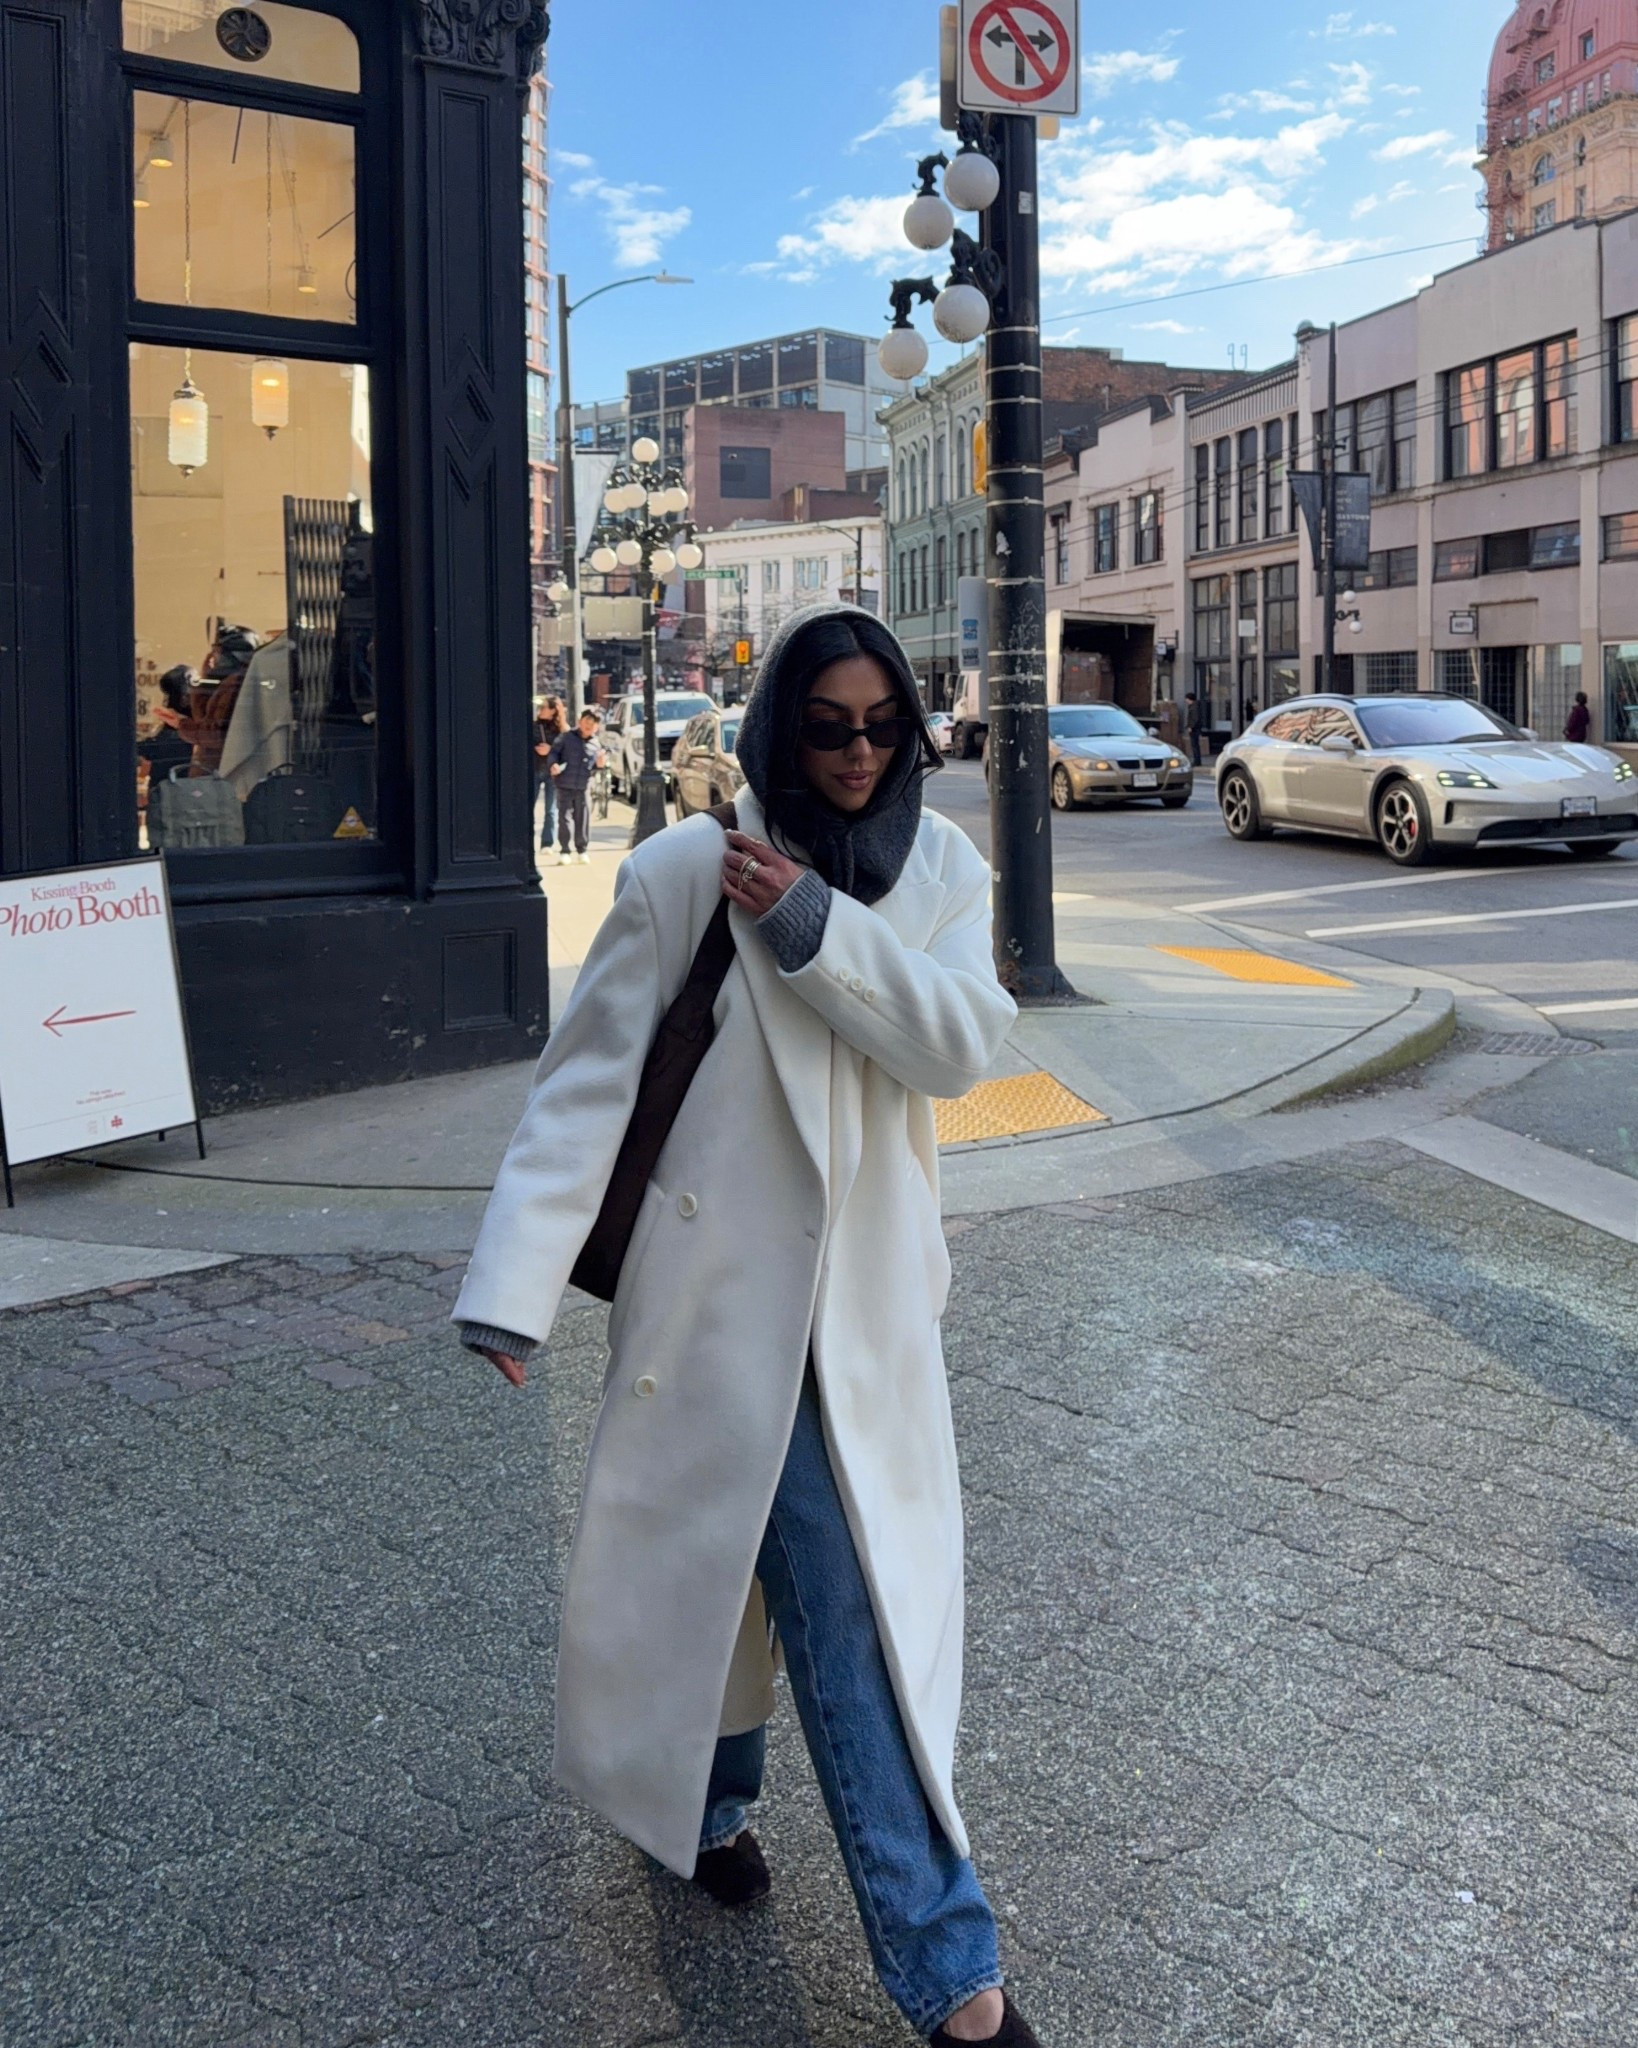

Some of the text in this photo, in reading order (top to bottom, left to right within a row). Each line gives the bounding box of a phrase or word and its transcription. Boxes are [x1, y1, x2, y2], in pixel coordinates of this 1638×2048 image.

[31, 878, 117, 901] Kissing Booth
[74, 886, 163, 926] Booth
